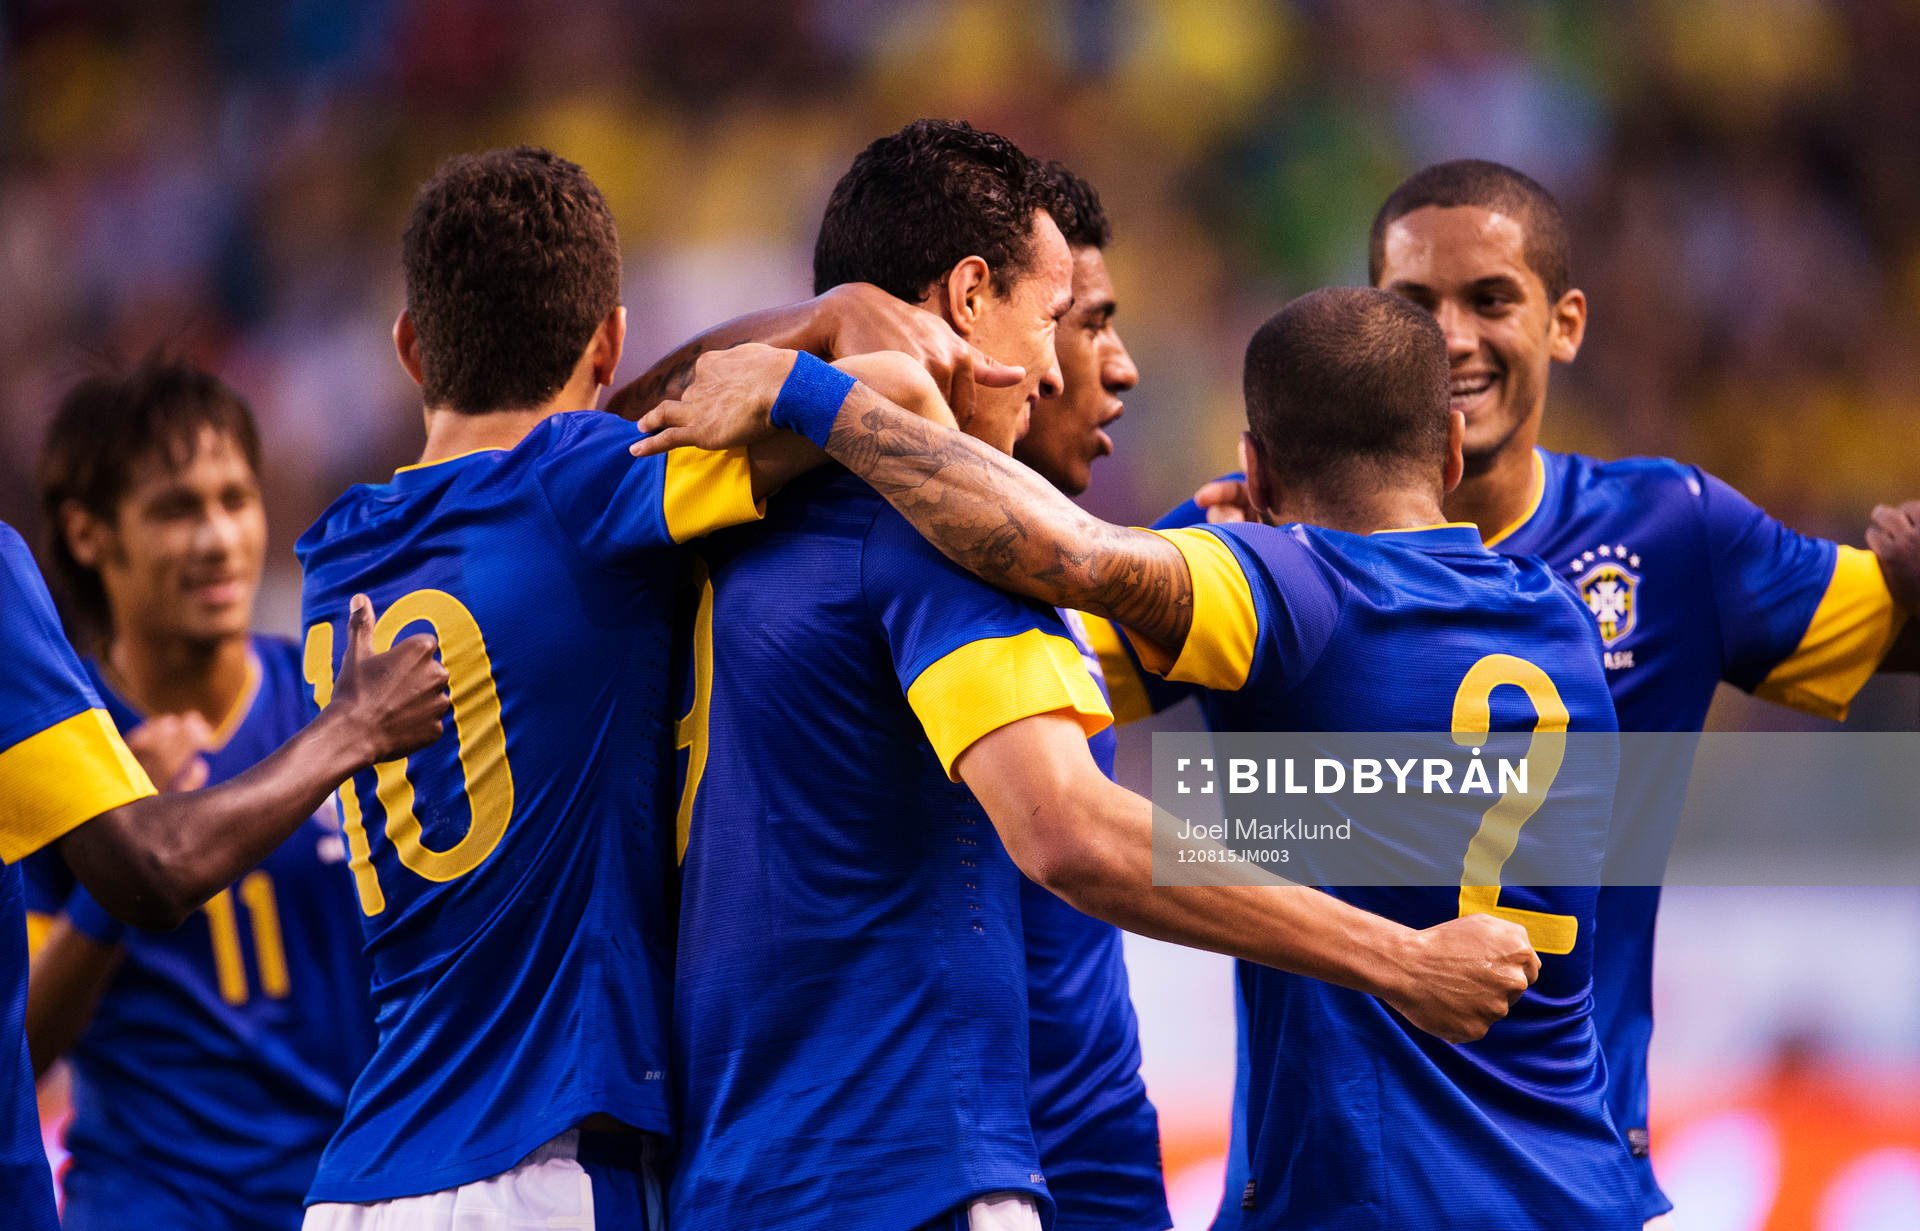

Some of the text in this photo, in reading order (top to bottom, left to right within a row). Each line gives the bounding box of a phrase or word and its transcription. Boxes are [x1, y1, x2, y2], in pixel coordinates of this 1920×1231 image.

[303, 588, 515, 917] 10
[1450, 653, 1579, 955] 2
[203, 870, 291, 1006] 11
